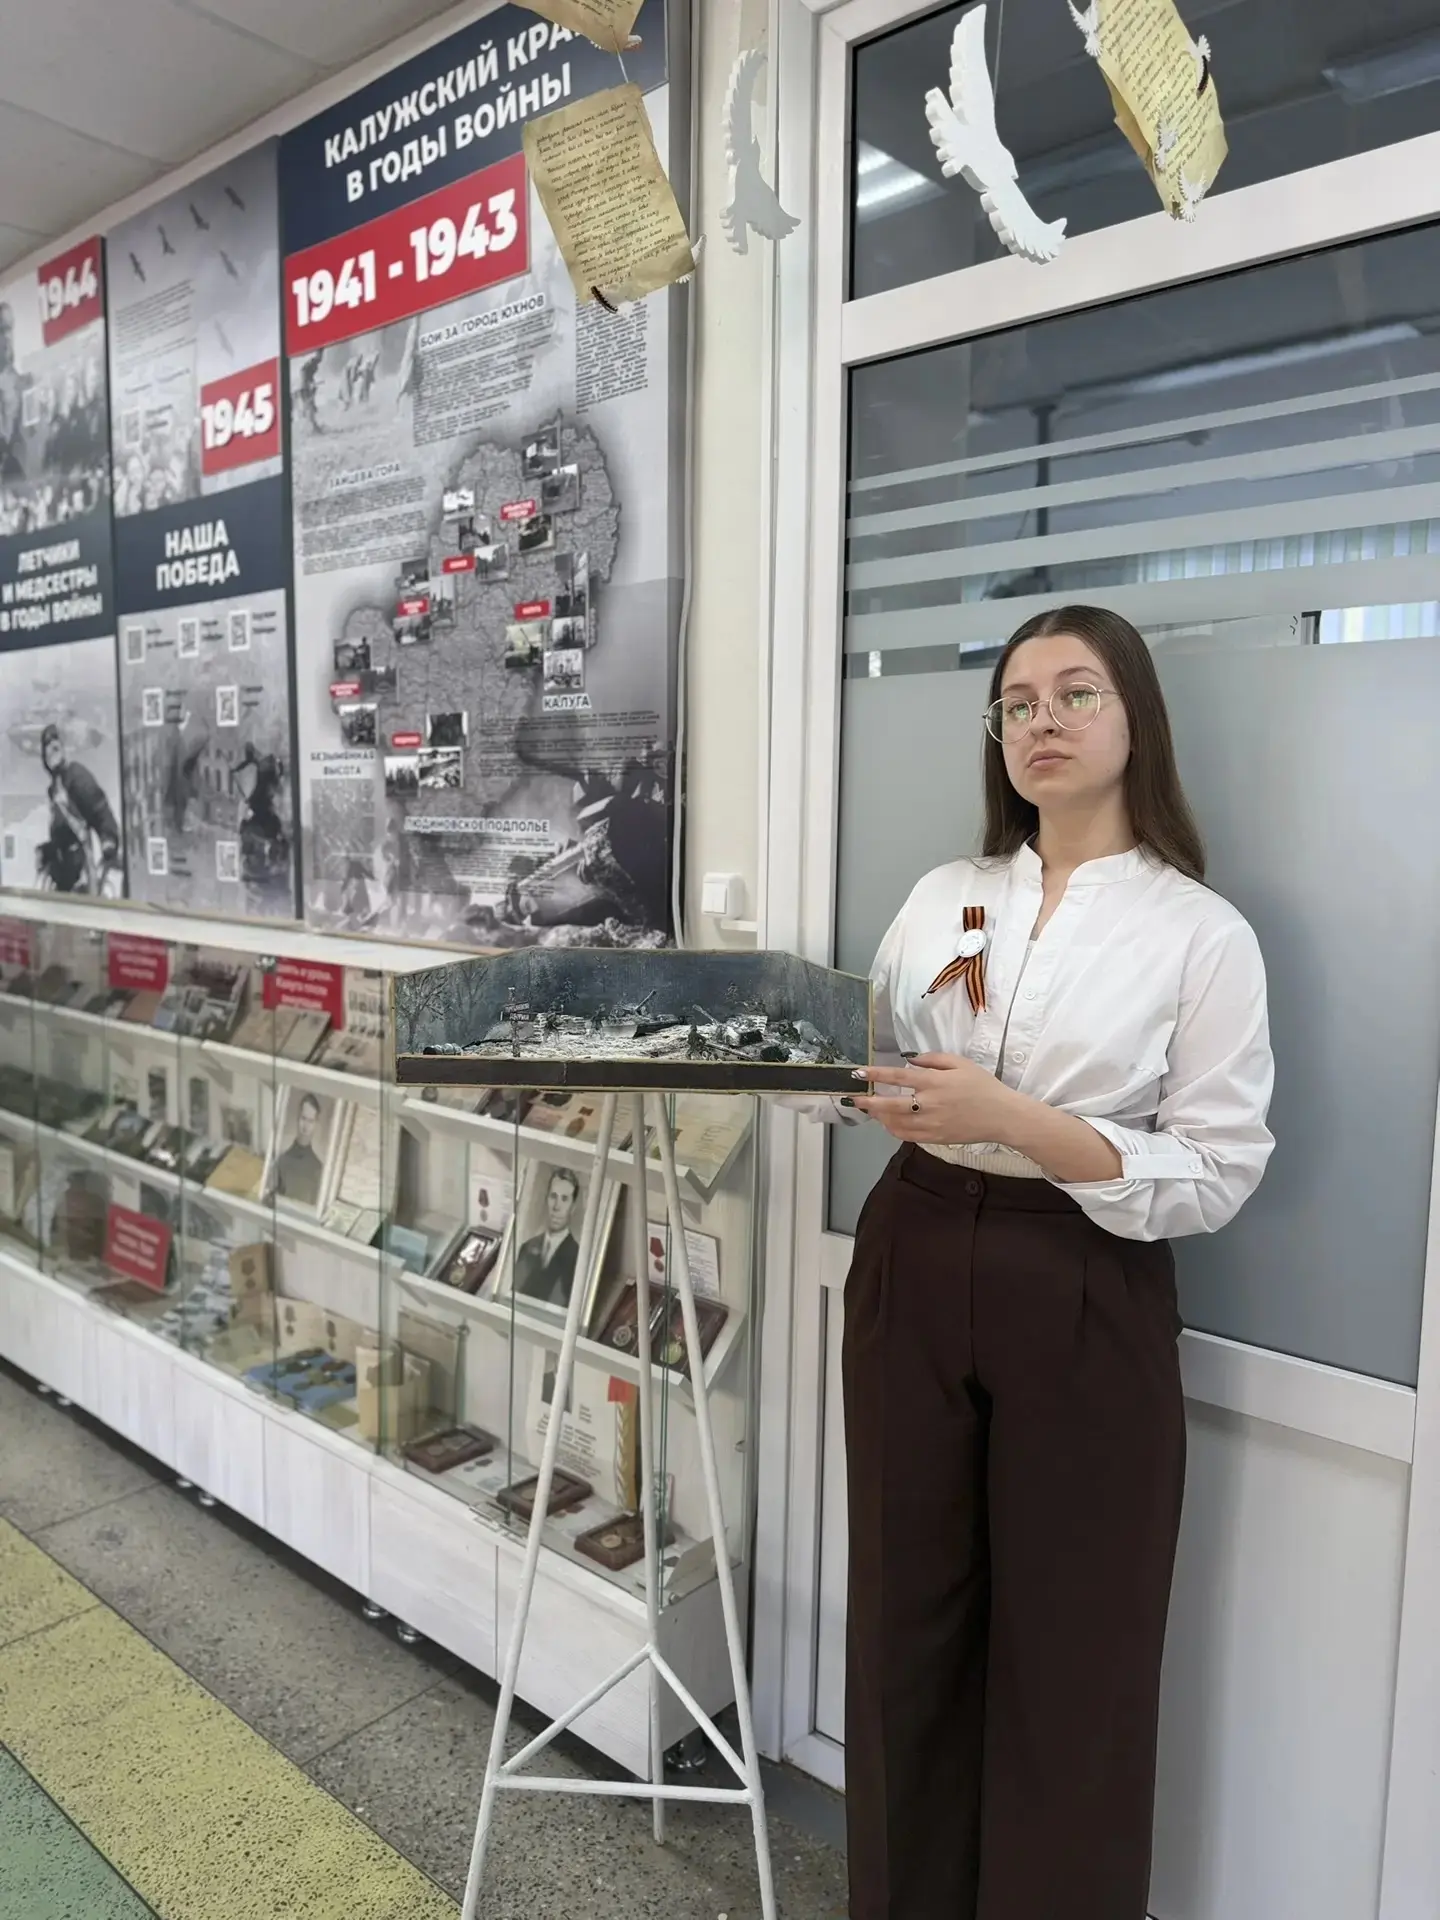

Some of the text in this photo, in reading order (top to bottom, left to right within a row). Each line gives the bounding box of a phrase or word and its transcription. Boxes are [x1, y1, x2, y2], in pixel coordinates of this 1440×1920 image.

[324, 21, 581, 168] КАЛУЖСКИЙ КРА
[346, 62, 572, 202] В ГОДЫ ВОЙНЫ
[292, 249, 376, 327] 1941
[409, 188, 518, 282] 1943
[38, 256, 98, 322] 1944
[462, 311, 499, 334] ГОРОД
[501, 294, 544, 320] ЮХНОВ
[200, 383, 275, 450] 1945
[164, 518, 230, 559] НАША
[2, 563, 98, 604] И МЕДСЕСТРЫ
[155, 548, 241, 592] ПОБЕДА
[0, 592, 104, 632] В ГОДЫ ВОЙНЫ
[544, 695, 590, 709] КАЛУГА
[486, 819, 549, 833] ПОДПОЛЬЕ
